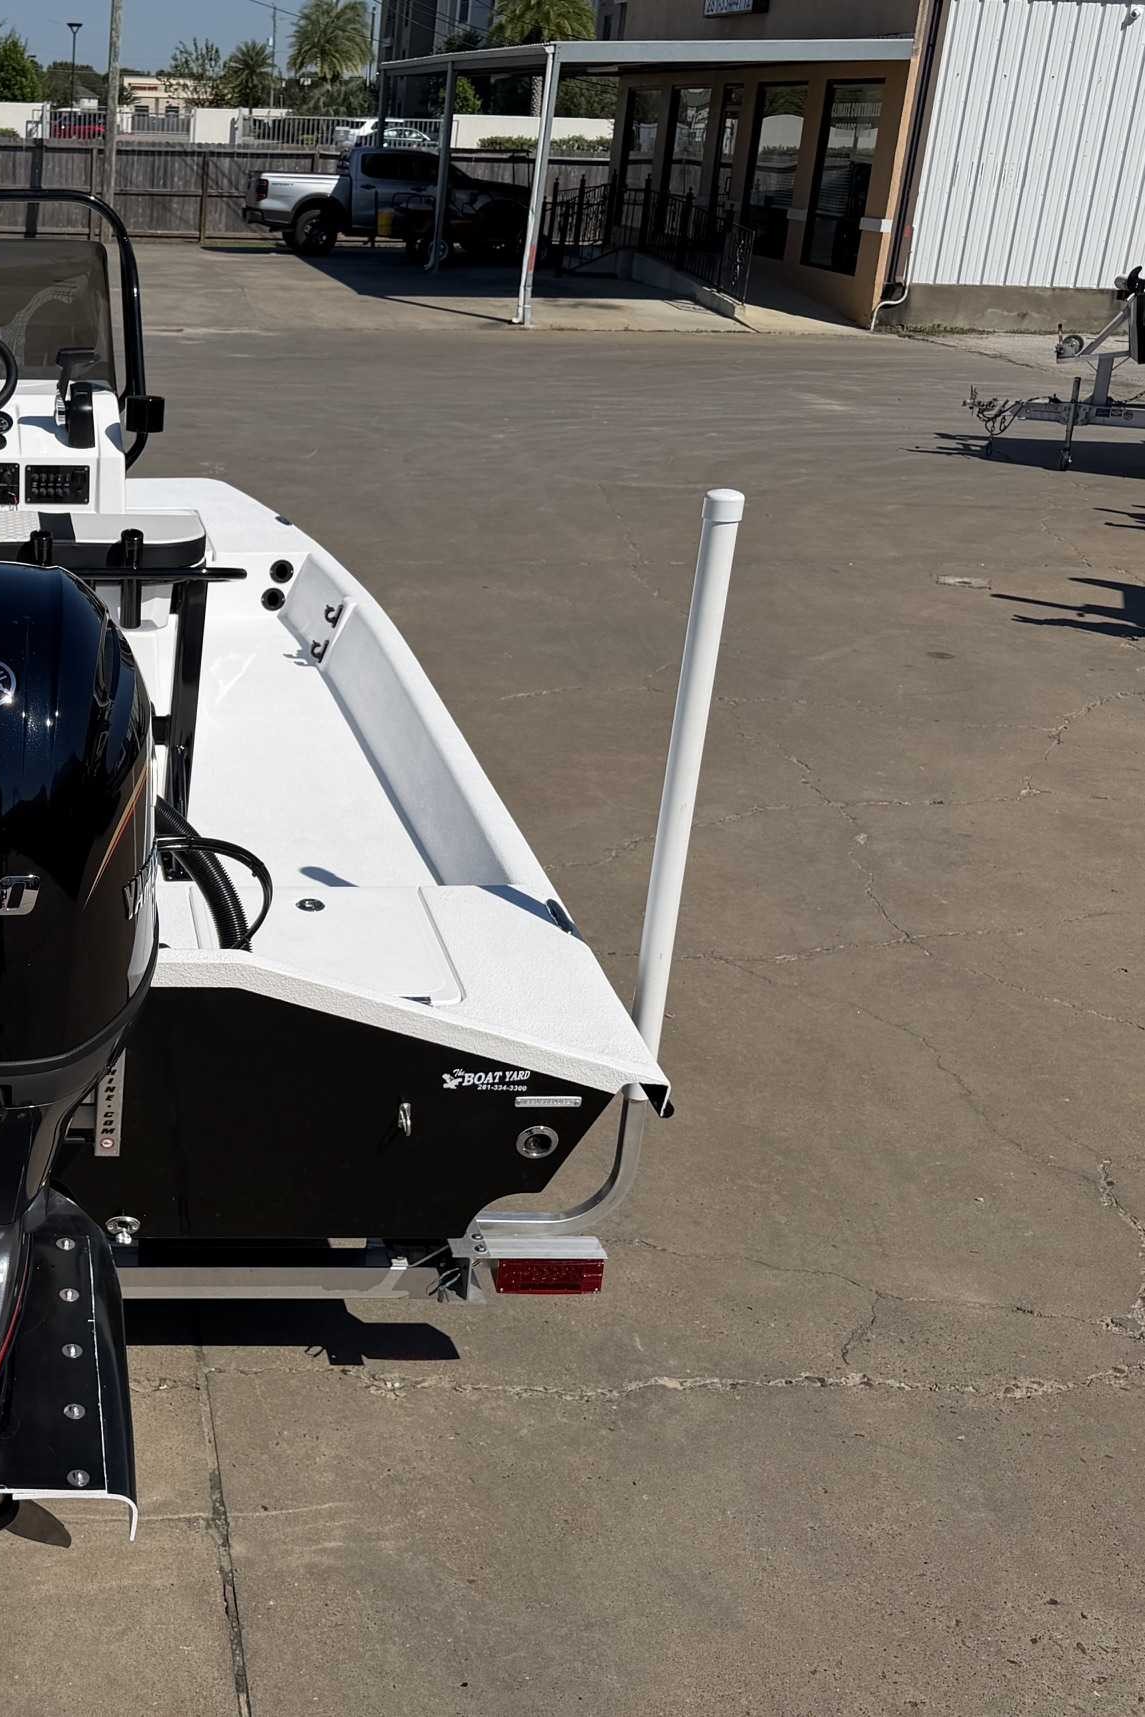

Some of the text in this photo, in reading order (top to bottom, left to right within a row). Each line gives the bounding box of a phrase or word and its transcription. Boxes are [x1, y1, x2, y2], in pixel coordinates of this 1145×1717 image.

[452, 1068, 531, 1086] The BOAT YARD
